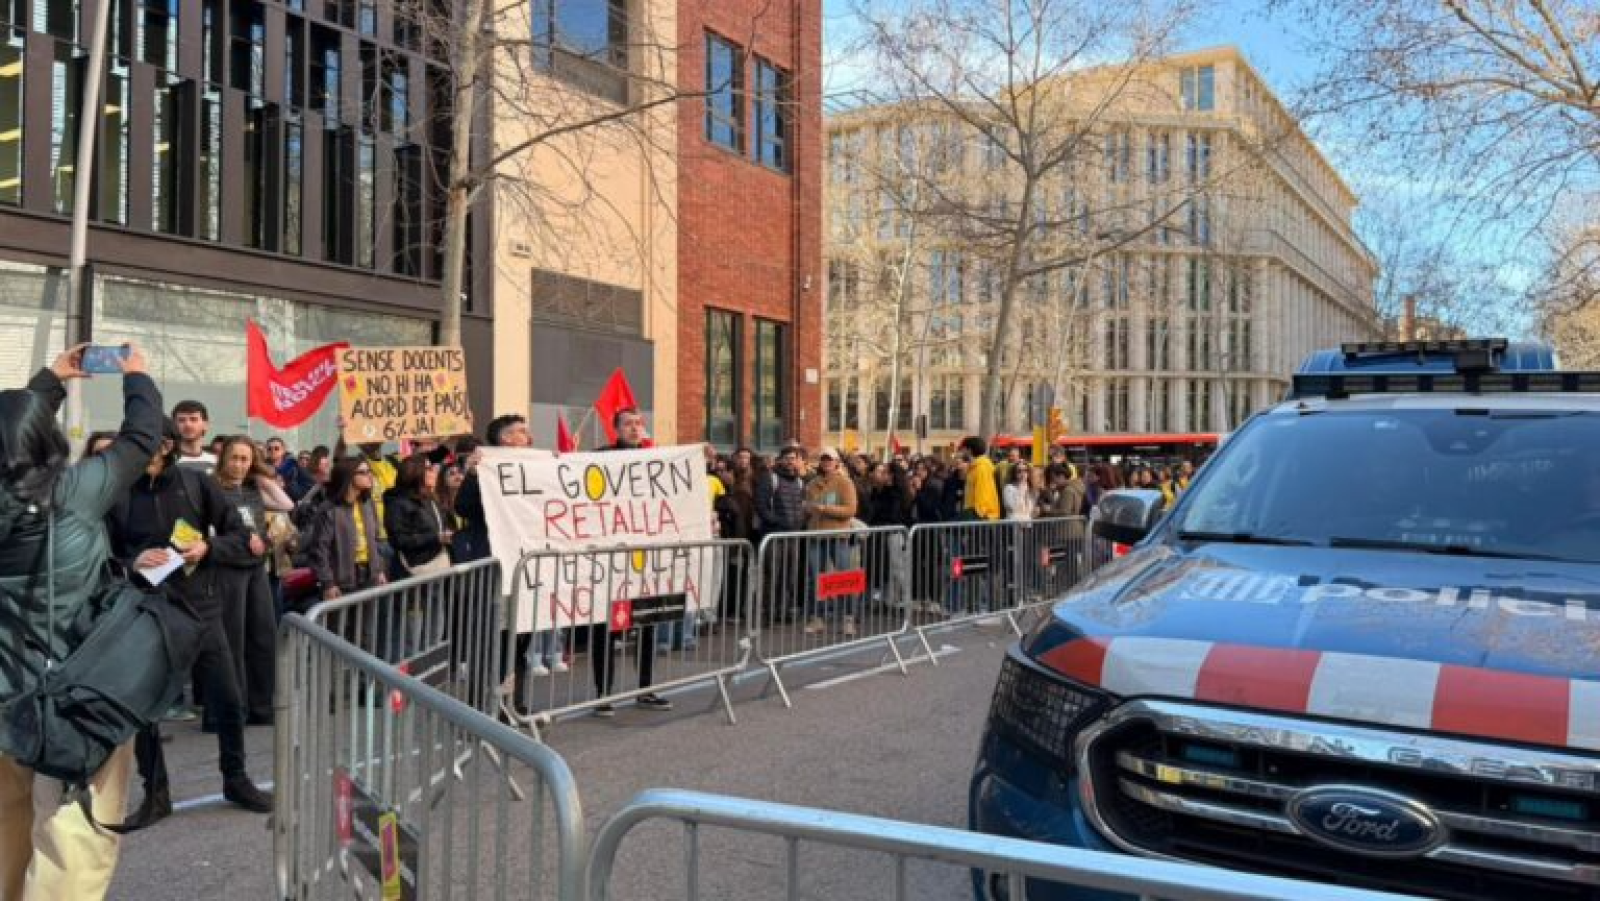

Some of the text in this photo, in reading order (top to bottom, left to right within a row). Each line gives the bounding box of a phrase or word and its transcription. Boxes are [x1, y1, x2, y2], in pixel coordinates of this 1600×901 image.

[343, 350, 463, 372] SENSE DOCENTS
[366, 373, 434, 396] NO HI HA
[350, 396, 407, 419] ACORD
[412, 395, 428, 415] DE
[498, 459, 692, 501] EL GOVERN
[544, 499, 679, 541] RETALLA
[551, 586, 593, 622] NO
[1322, 802, 1400, 841] Ford
